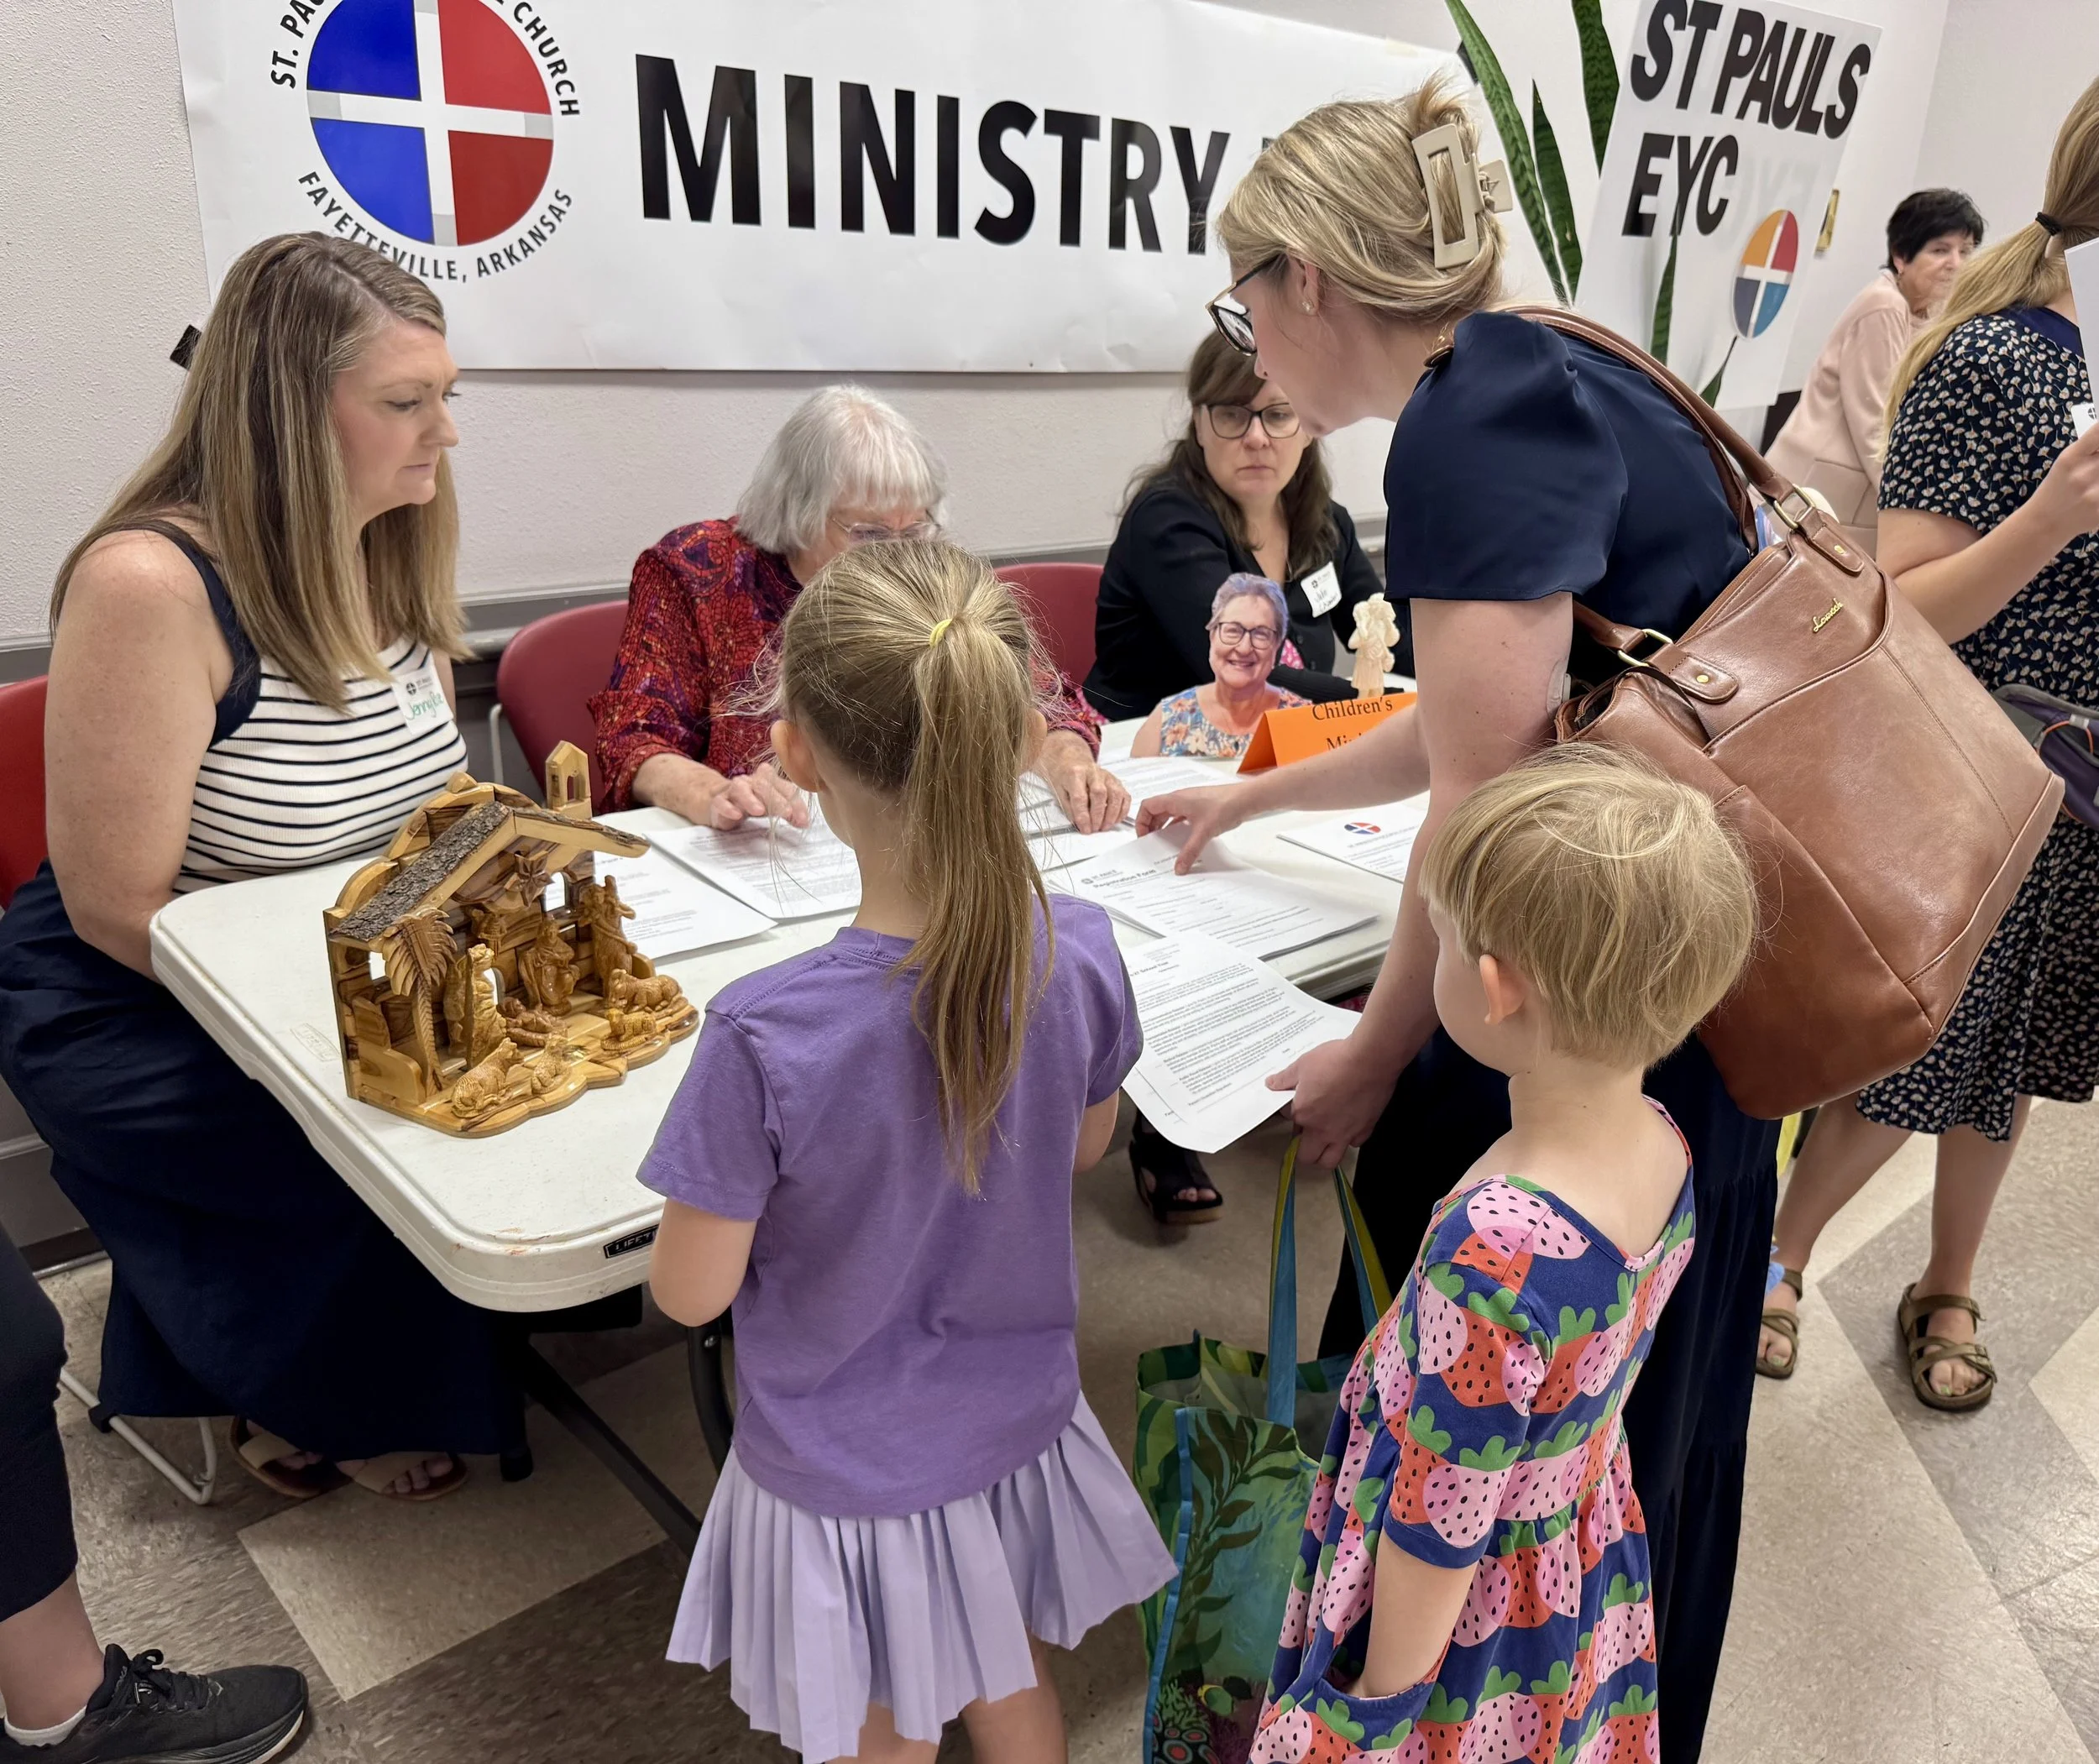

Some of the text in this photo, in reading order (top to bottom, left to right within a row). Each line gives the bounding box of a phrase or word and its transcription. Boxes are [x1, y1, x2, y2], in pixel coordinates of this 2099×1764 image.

[270, 0, 325, 89] ST. PA
[513, 2, 580, 116] CHURCH
[1631, 0, 1871, 140] ST PAULS
[636, 53, 1231, 256] MINISTRY
[1621, 132, 1739, 238] EYC
[476, 187, 573, 278] ARKANSAS
[1312, 696, 1393, 720] Children's
